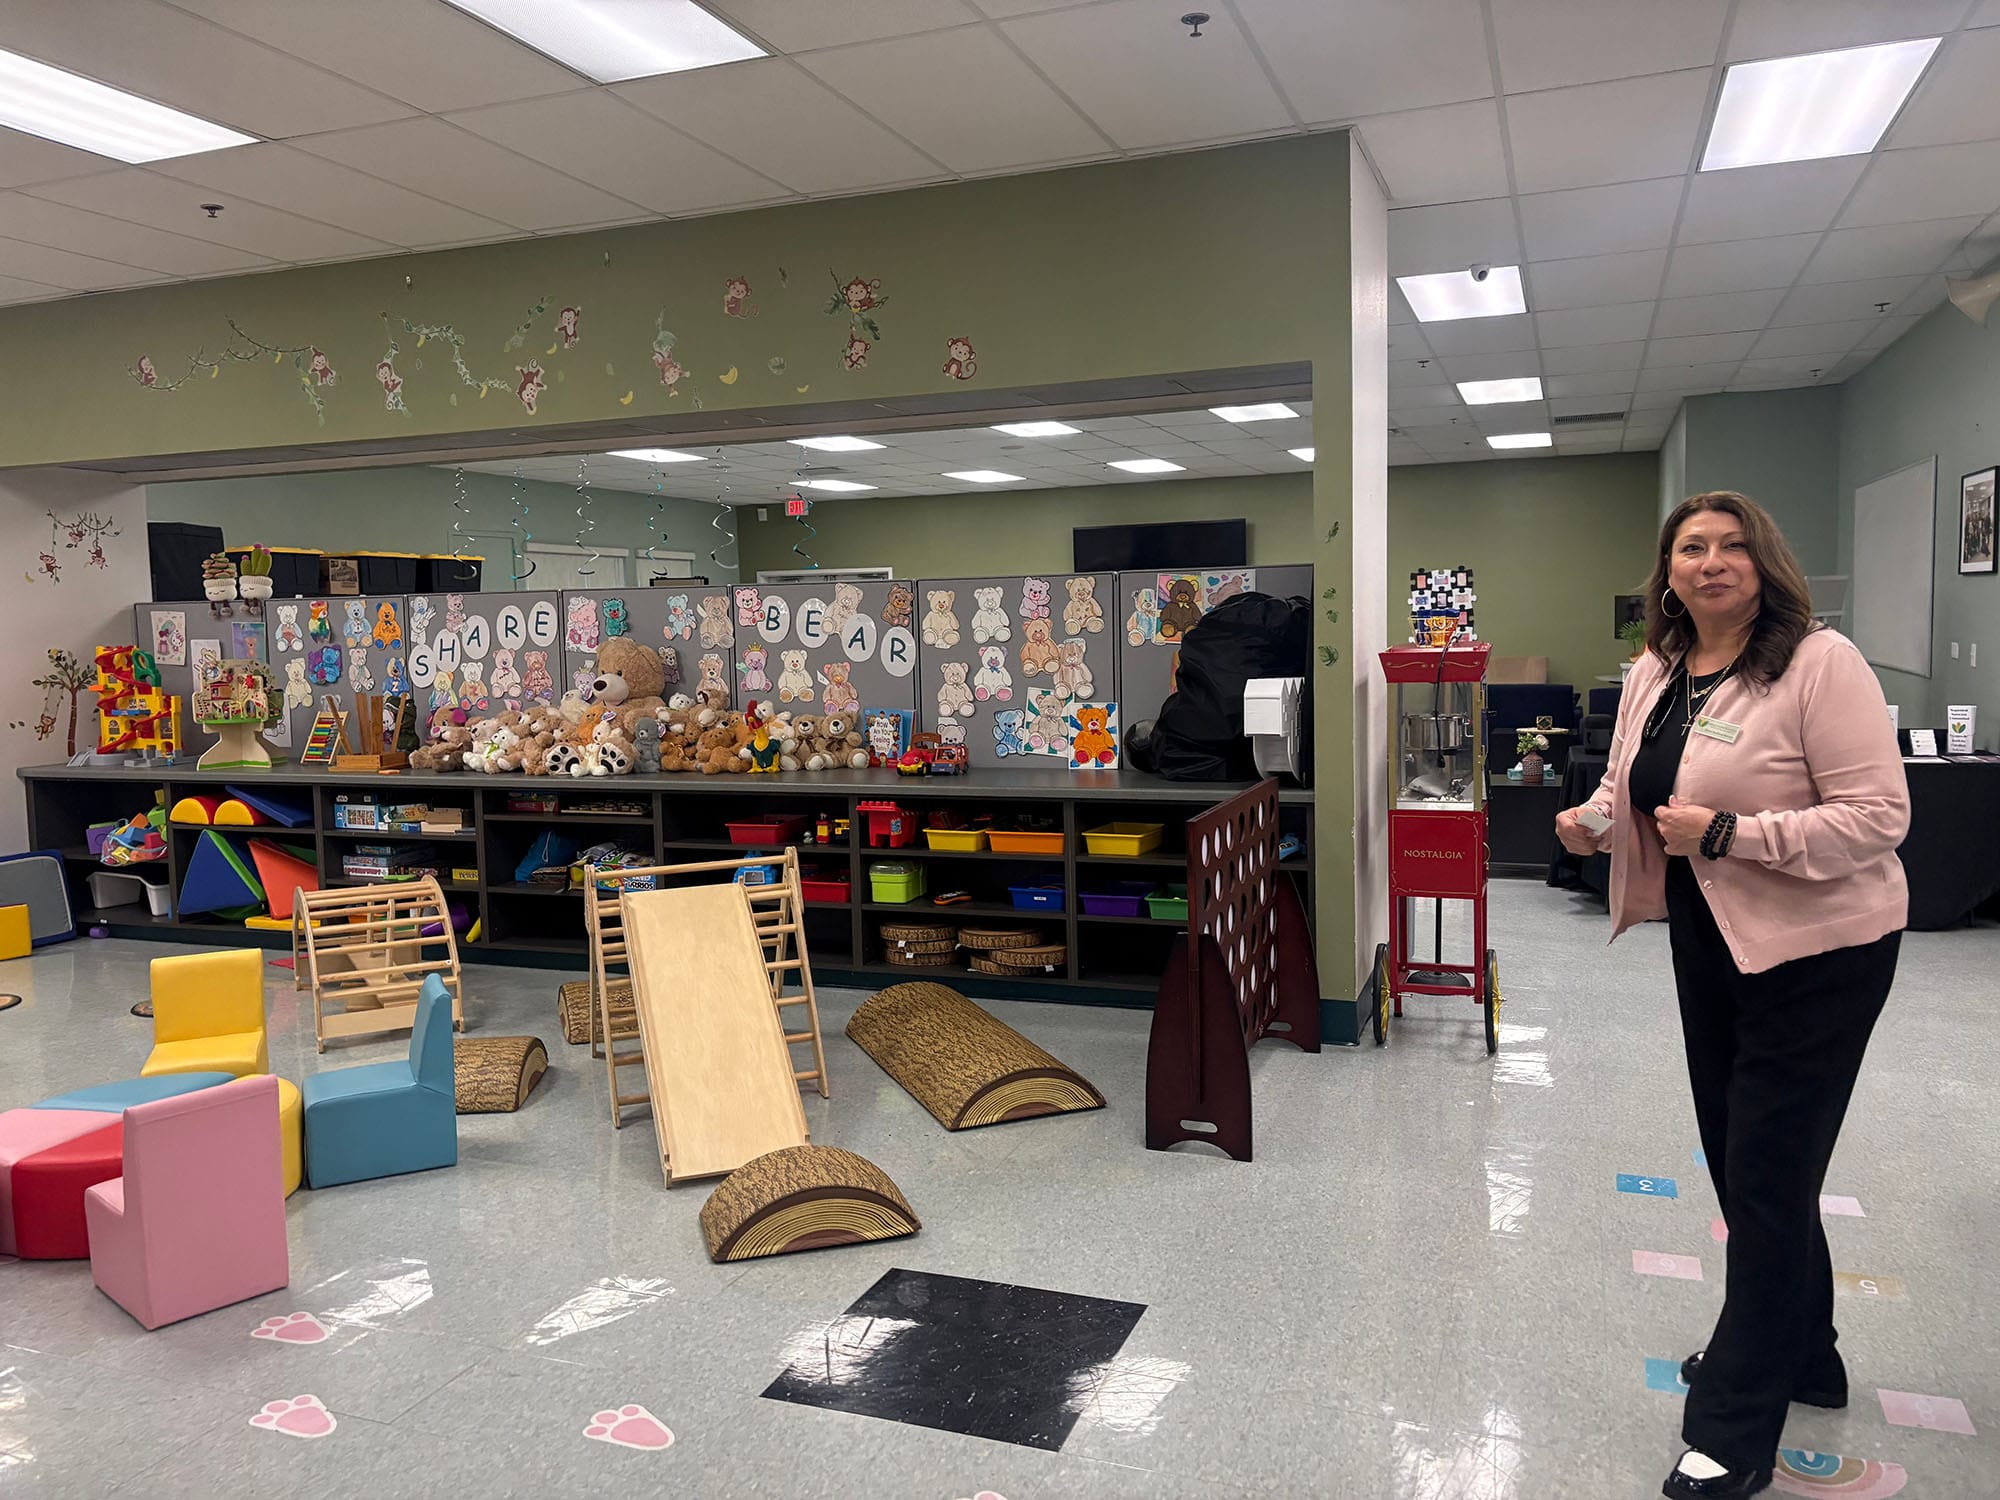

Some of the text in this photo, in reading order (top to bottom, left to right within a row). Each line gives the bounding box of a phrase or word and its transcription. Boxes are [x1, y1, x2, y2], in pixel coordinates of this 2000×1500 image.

[788, 500, 804, 514] EXIT
[415, 605, 907, 676] SHARE BEAR
[1403, 849, 1463, 860] NOSTALGIA
